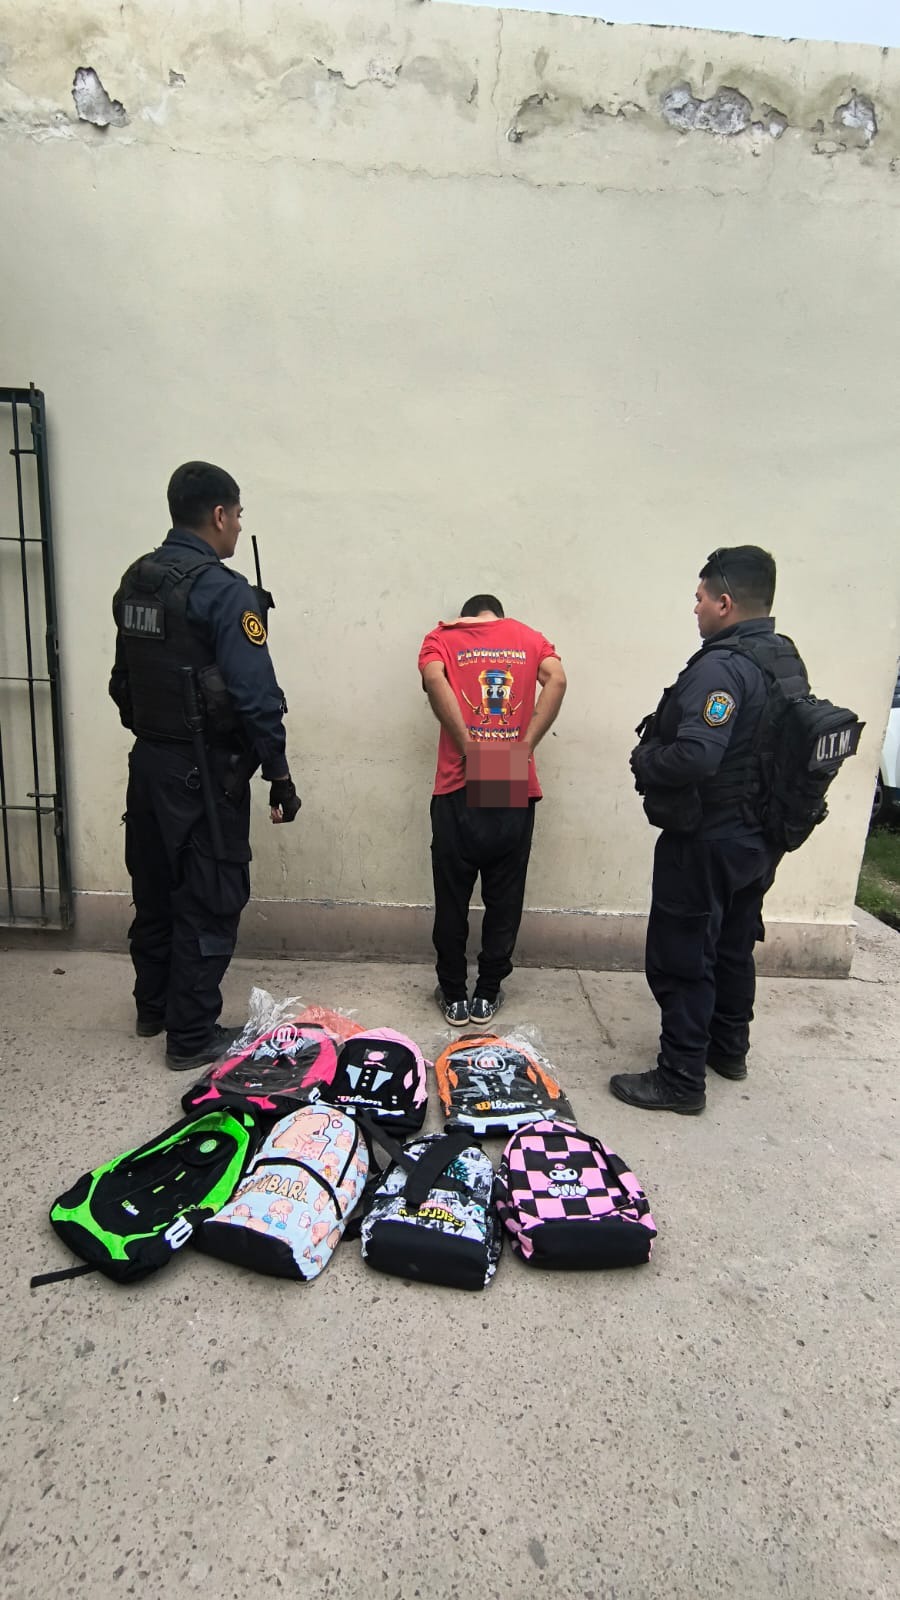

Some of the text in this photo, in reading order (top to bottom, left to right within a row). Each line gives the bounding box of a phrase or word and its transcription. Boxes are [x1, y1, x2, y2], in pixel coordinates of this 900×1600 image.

[124, 605, 160, 633] U.T.M.
[816, 729, 851, 761] U.T.M.
[475, 1100, 526, 1110] Wilson
